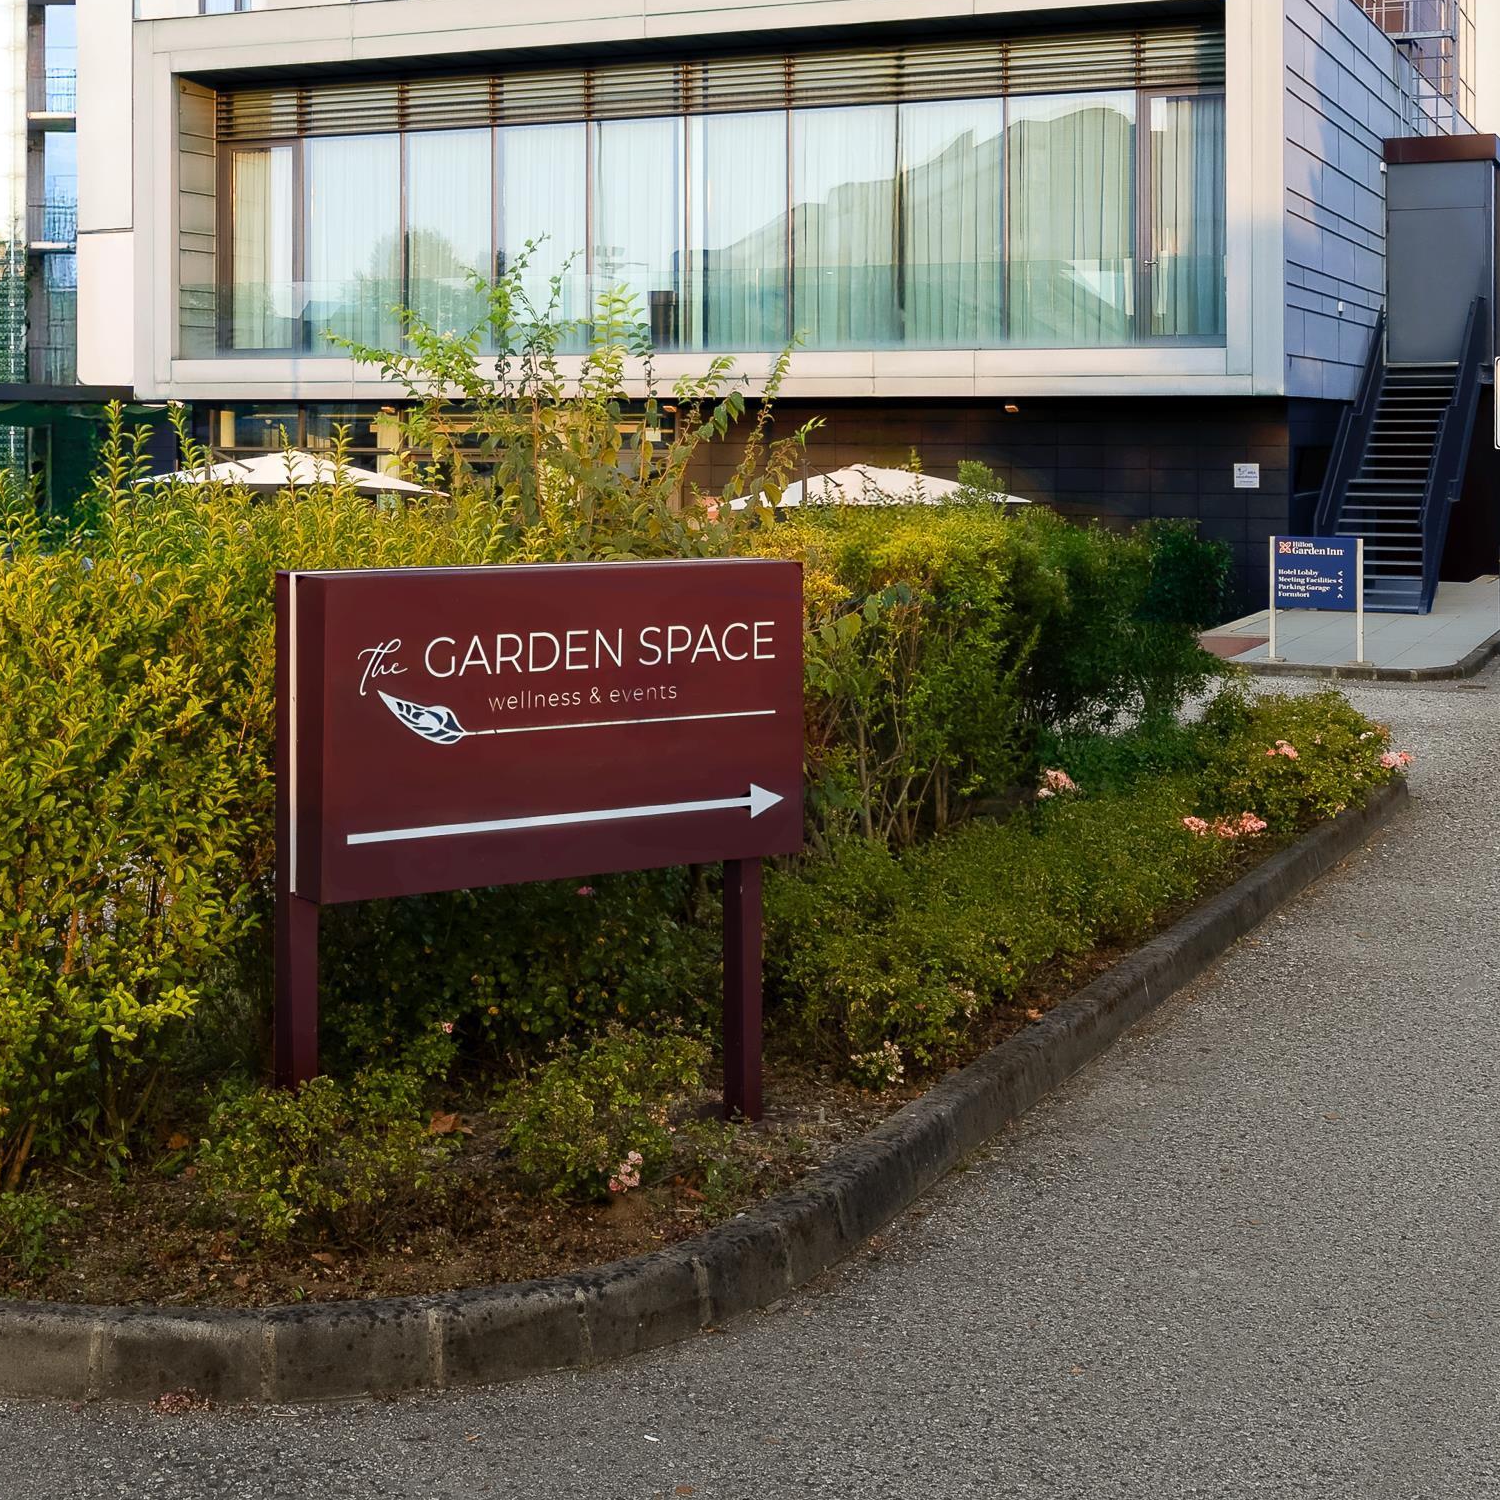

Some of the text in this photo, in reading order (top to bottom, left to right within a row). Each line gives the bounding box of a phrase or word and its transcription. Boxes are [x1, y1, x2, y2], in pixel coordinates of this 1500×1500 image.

[1292, 547, 1344, 556] Garden Inn
[1297, 569, 1319, 577] Lobby
[1278, 576, 1305, 584] Meeting
[424, 628, 623, 678] GARDEN
[638, 621, 776, 666] SPACE
[488, 682, 677, 712] wellness & events
